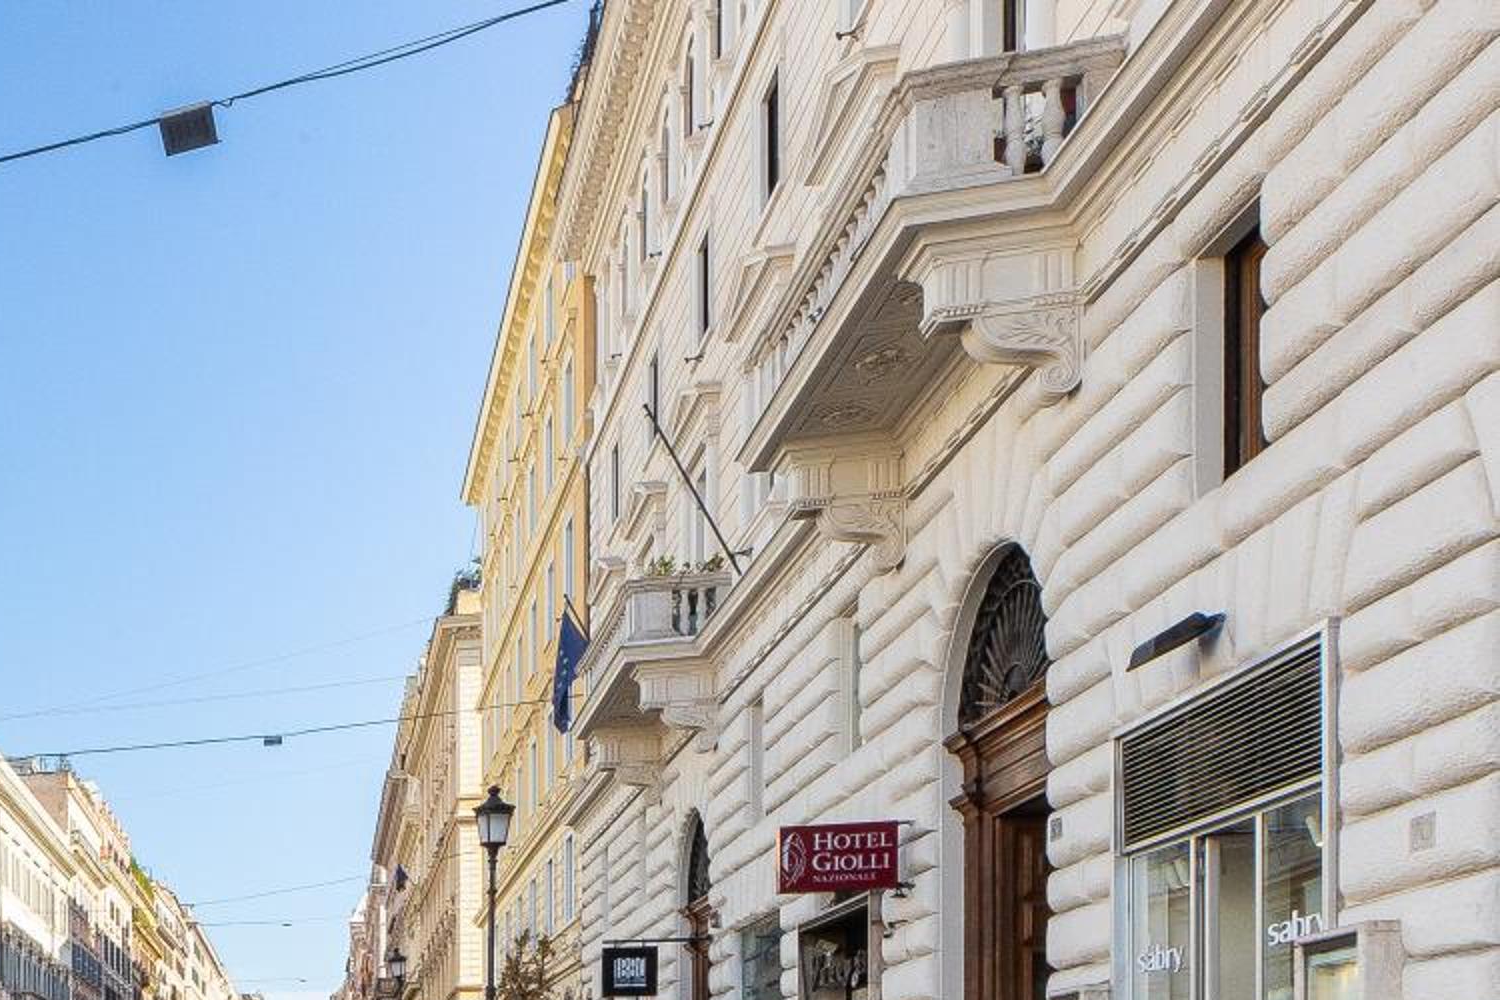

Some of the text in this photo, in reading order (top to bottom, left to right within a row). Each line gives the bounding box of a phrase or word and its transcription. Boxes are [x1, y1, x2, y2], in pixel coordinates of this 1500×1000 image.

[813, 832, 893, 850] HOTEL
[812, 853, 890, 871] GIOLLI
[1137, 944, 1183, 973] sabry
